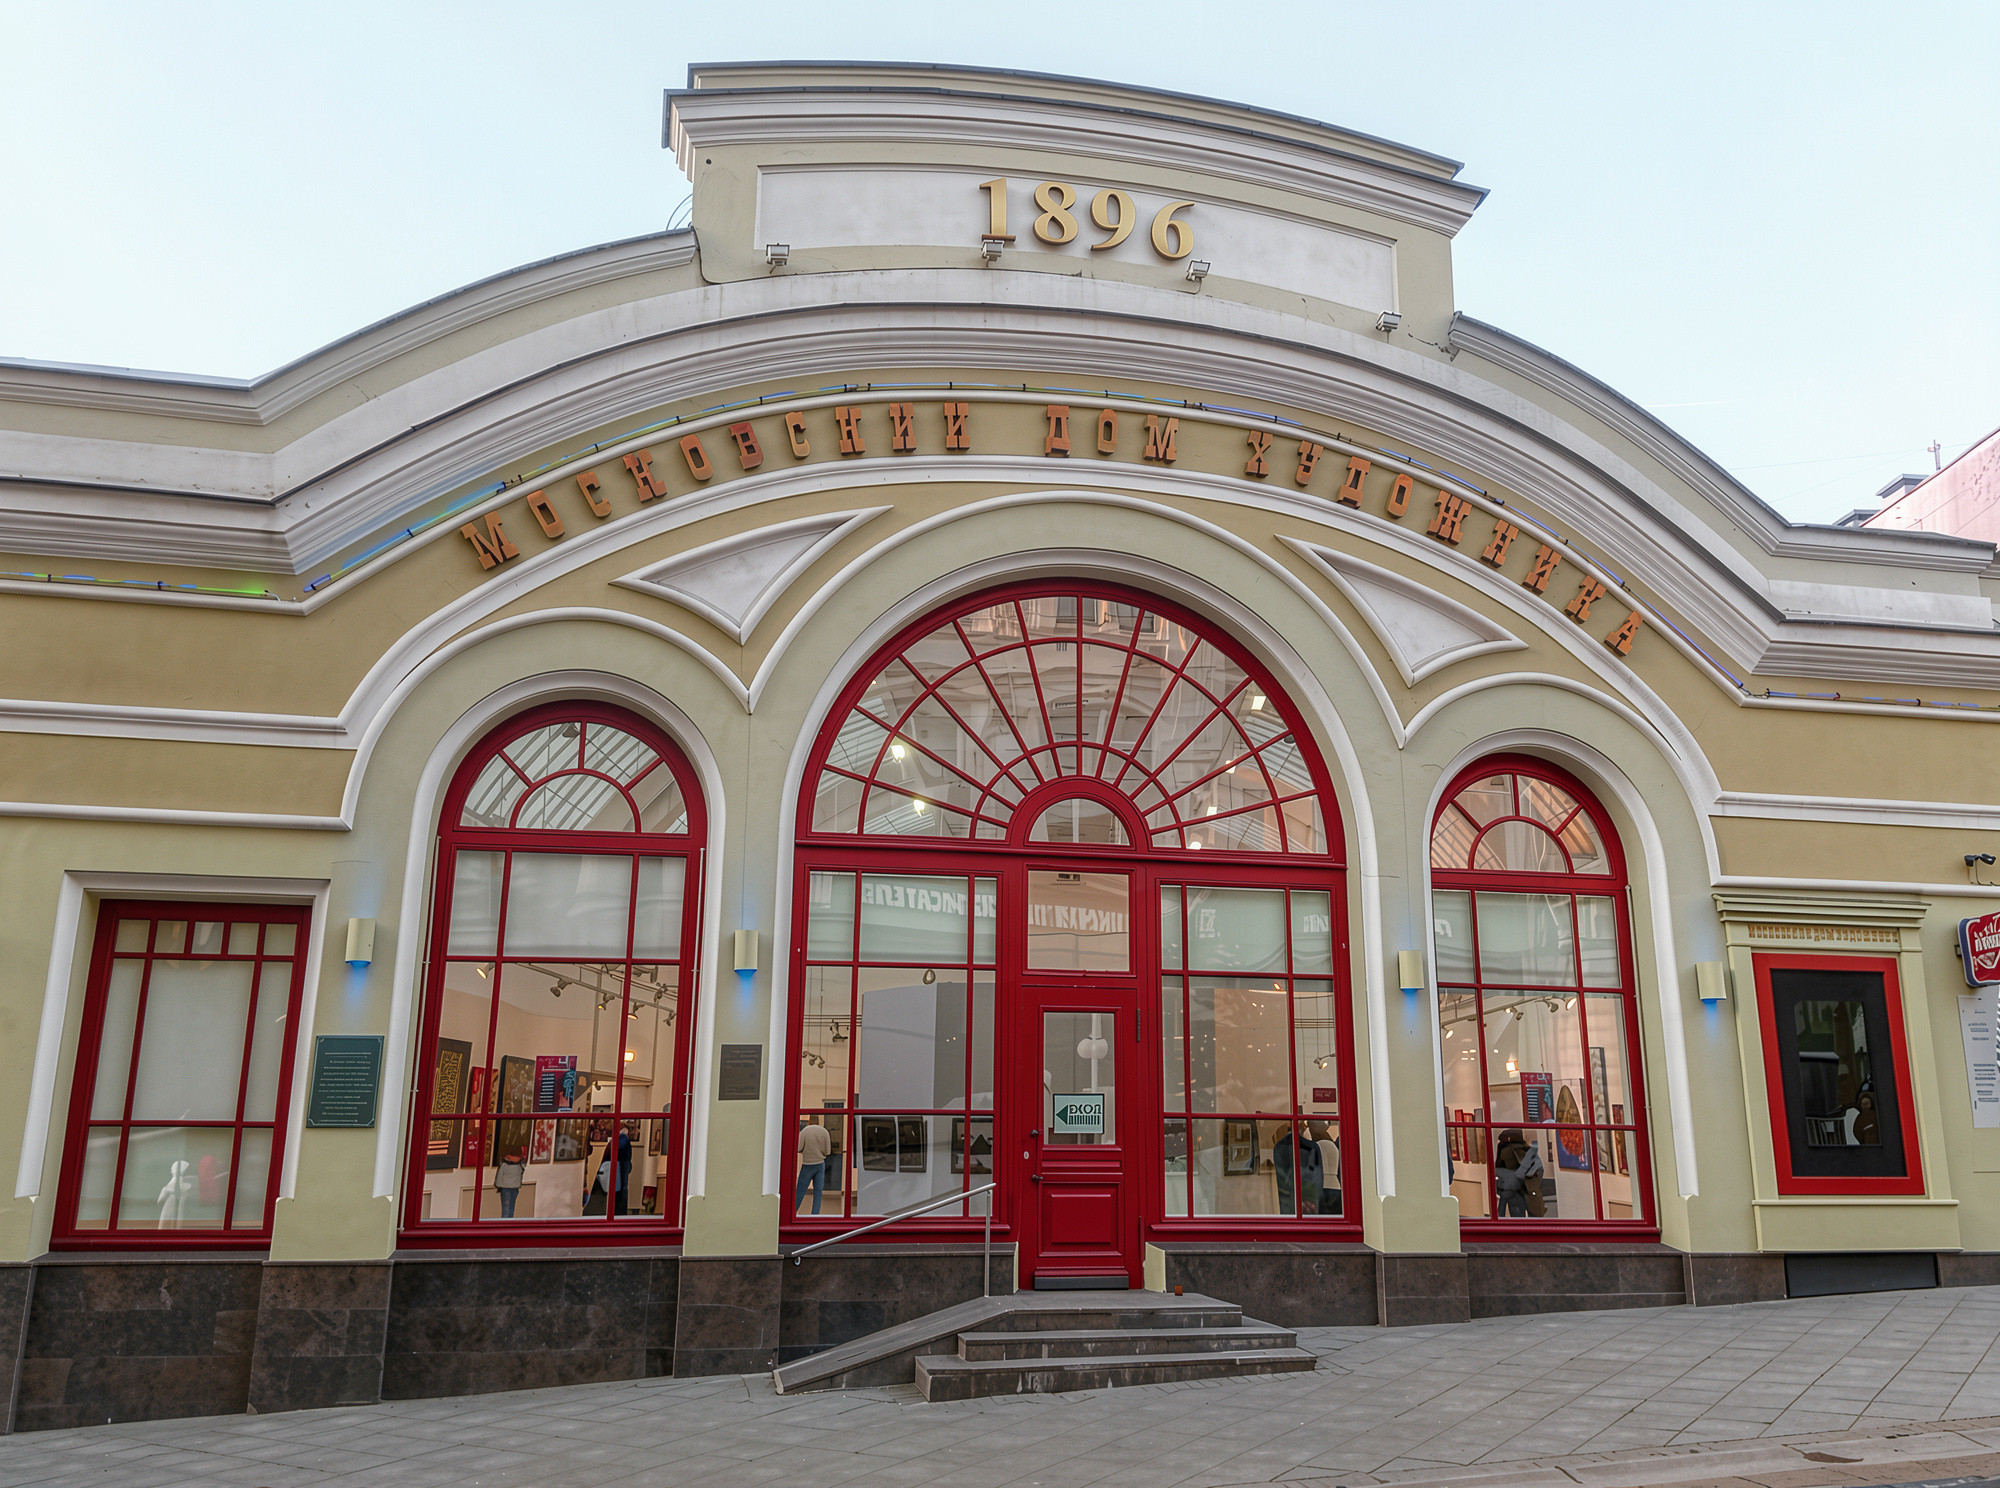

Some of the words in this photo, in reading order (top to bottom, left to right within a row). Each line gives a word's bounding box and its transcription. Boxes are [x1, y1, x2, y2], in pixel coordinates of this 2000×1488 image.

[979, 177, 1195, 260] 1896
[1044, 404, 1179, 464] ДОМ
[1244, 429, 1644, 657] ХУДОЖНИКА
